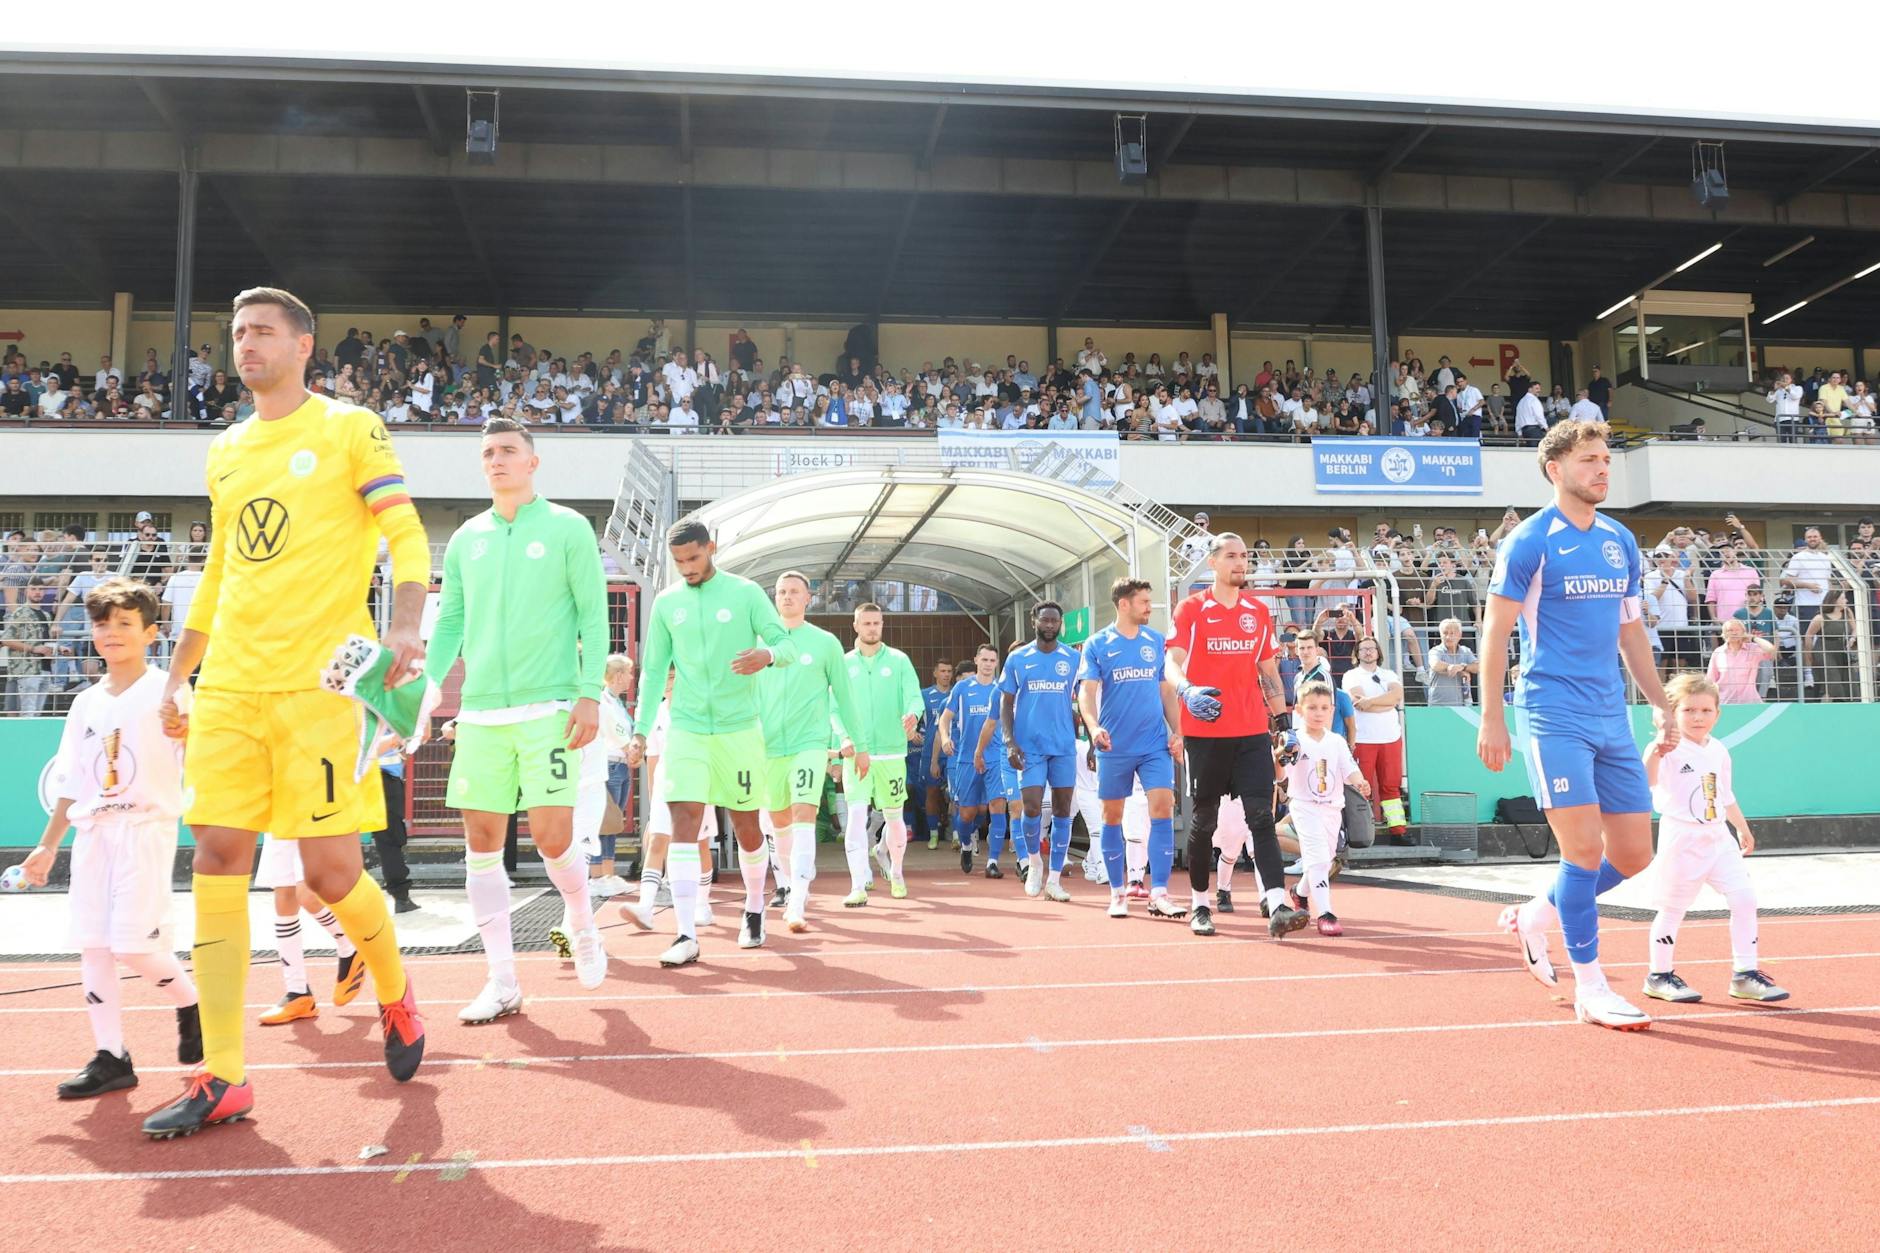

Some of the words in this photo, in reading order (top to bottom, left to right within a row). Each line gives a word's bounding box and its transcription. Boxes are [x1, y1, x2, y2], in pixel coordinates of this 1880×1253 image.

[941, 446, 1008, 457] MAKKABI
[1320, 453, 1372, 465] MAKKABI
[1422, 455, 1473, 466] MAKKABI
[1326, 465, 1367, 475] BERLIN
[1564, 578, 1629, 594] KUNDLER
[1207, 639, 1255, 651] KUNDLER
[1113, 668, 1154, 681] KUNDLER
[1028, 682, 1065, 691] KUNDLER
[550, 748, 567, 779] 5
[321, 758, 334, 802] 1
[738, 770, 751, 795] 4
[797, 768, 814, 788] 31
[1553, 777, 1569, 793] 20
